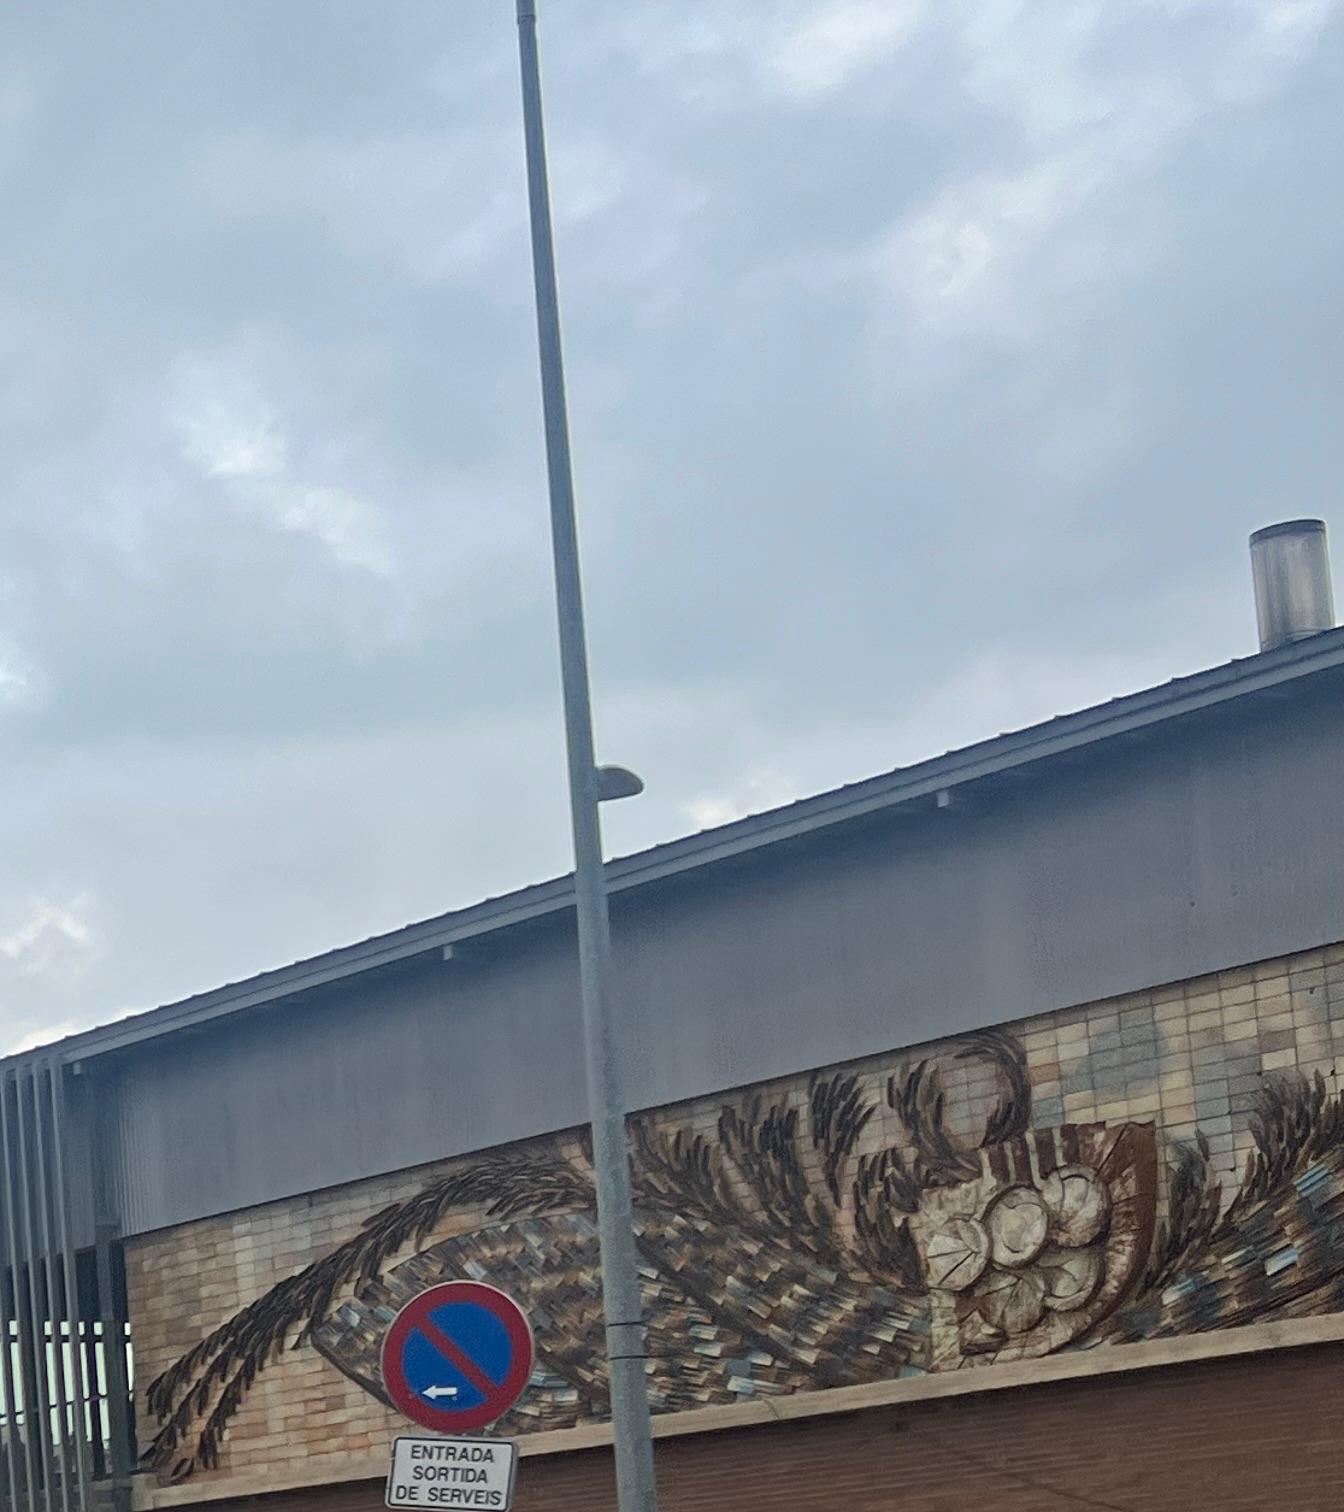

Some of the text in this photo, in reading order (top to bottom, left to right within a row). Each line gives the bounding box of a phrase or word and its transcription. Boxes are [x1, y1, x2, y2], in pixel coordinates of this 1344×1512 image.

[411, 1445, 494, 1463] ENTRADA
[413, 1465, 488, 1483] SORTIDA
[396, 1485, 503, 1506] DE SERVEIS
